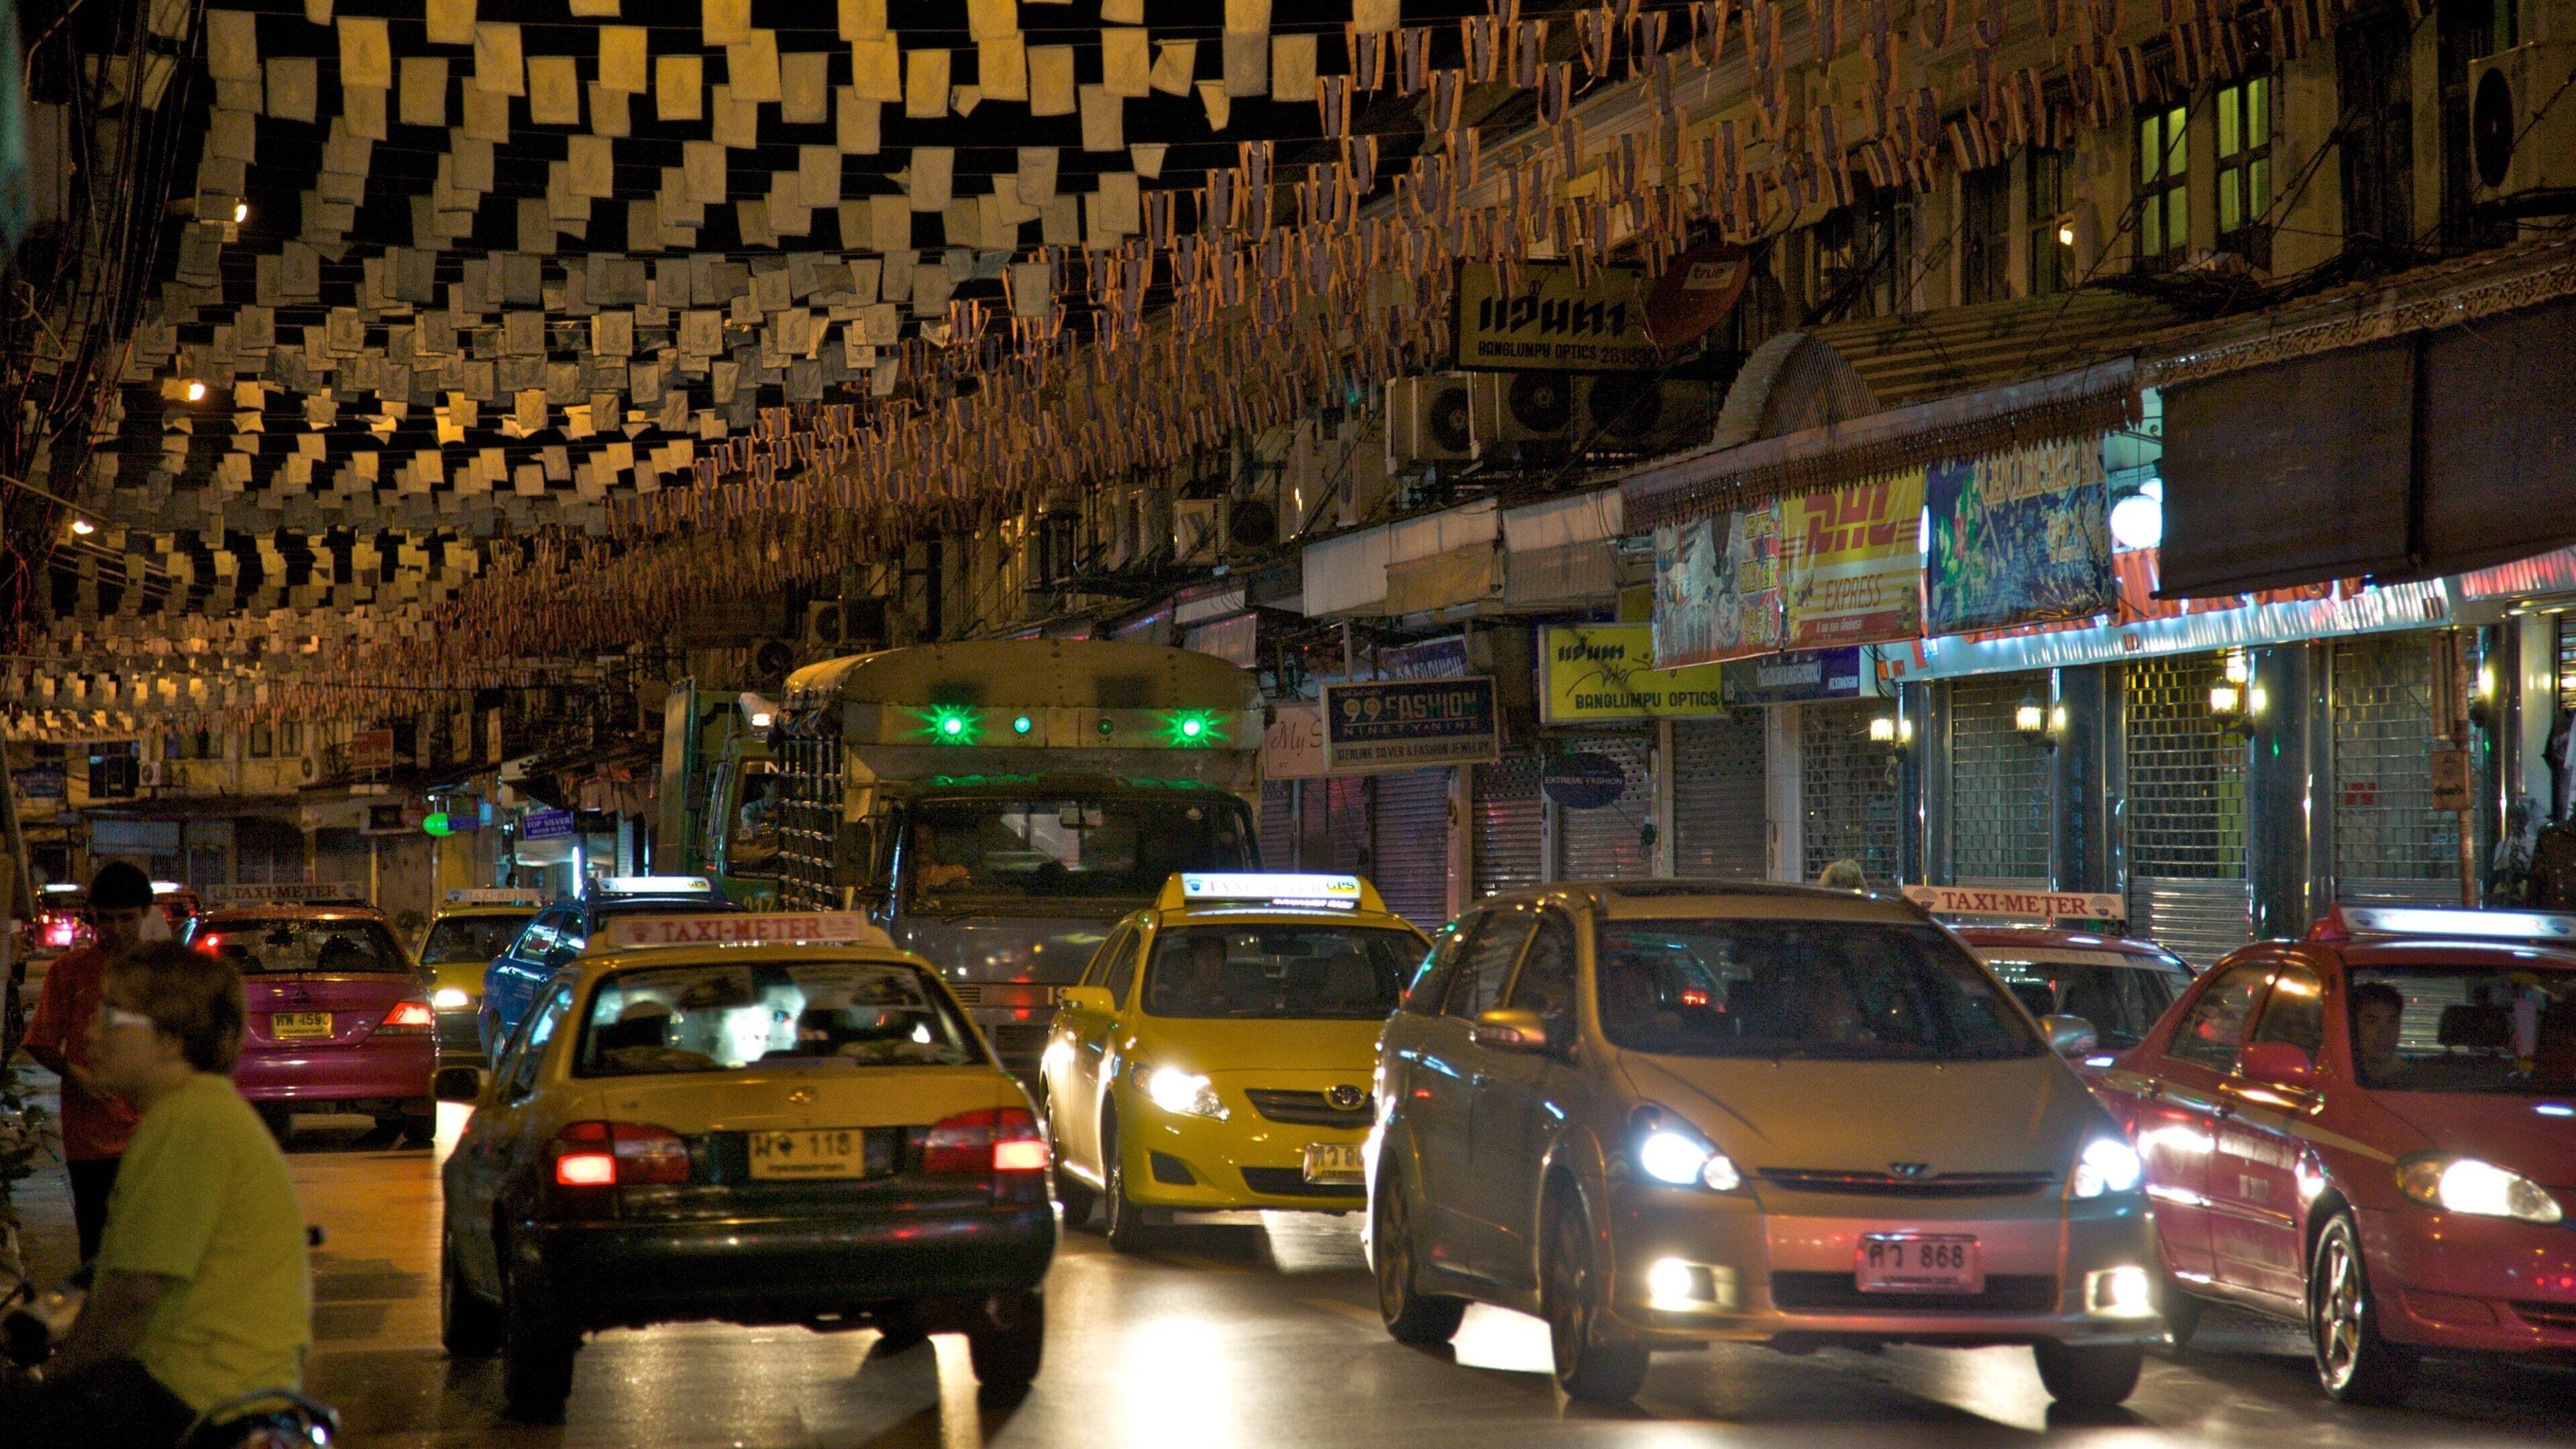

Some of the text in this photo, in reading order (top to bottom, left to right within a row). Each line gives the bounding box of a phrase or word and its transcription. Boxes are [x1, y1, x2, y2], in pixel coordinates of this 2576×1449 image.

[1555, 344, 1597, 360] OPTICS
[1805, 481, 1897, 555] DHL
[1825, 574, 1883, 612] EXPRESS
[1342, 691, 1478, 722] 99 FASHION
[1575, 692, 1719, 709] BANGLUMPU OPTICS
[1271, 718, 1322, 756] My S
[1336, 747, 1373, 761] STERLING
[1375, 745, 1405, 759] SILVER
[1545, 776, 1623, 784] EXTREME FASHION
[232, 885, 338, 899] TAXI-METER
[1326, 881, 1356, 890] GPS
[1941, 892, 2089, 915] TAXI-METER
[660, 918, 822, 942] TAXI-METER
[1920, 1244, 1964, 1268] 868
